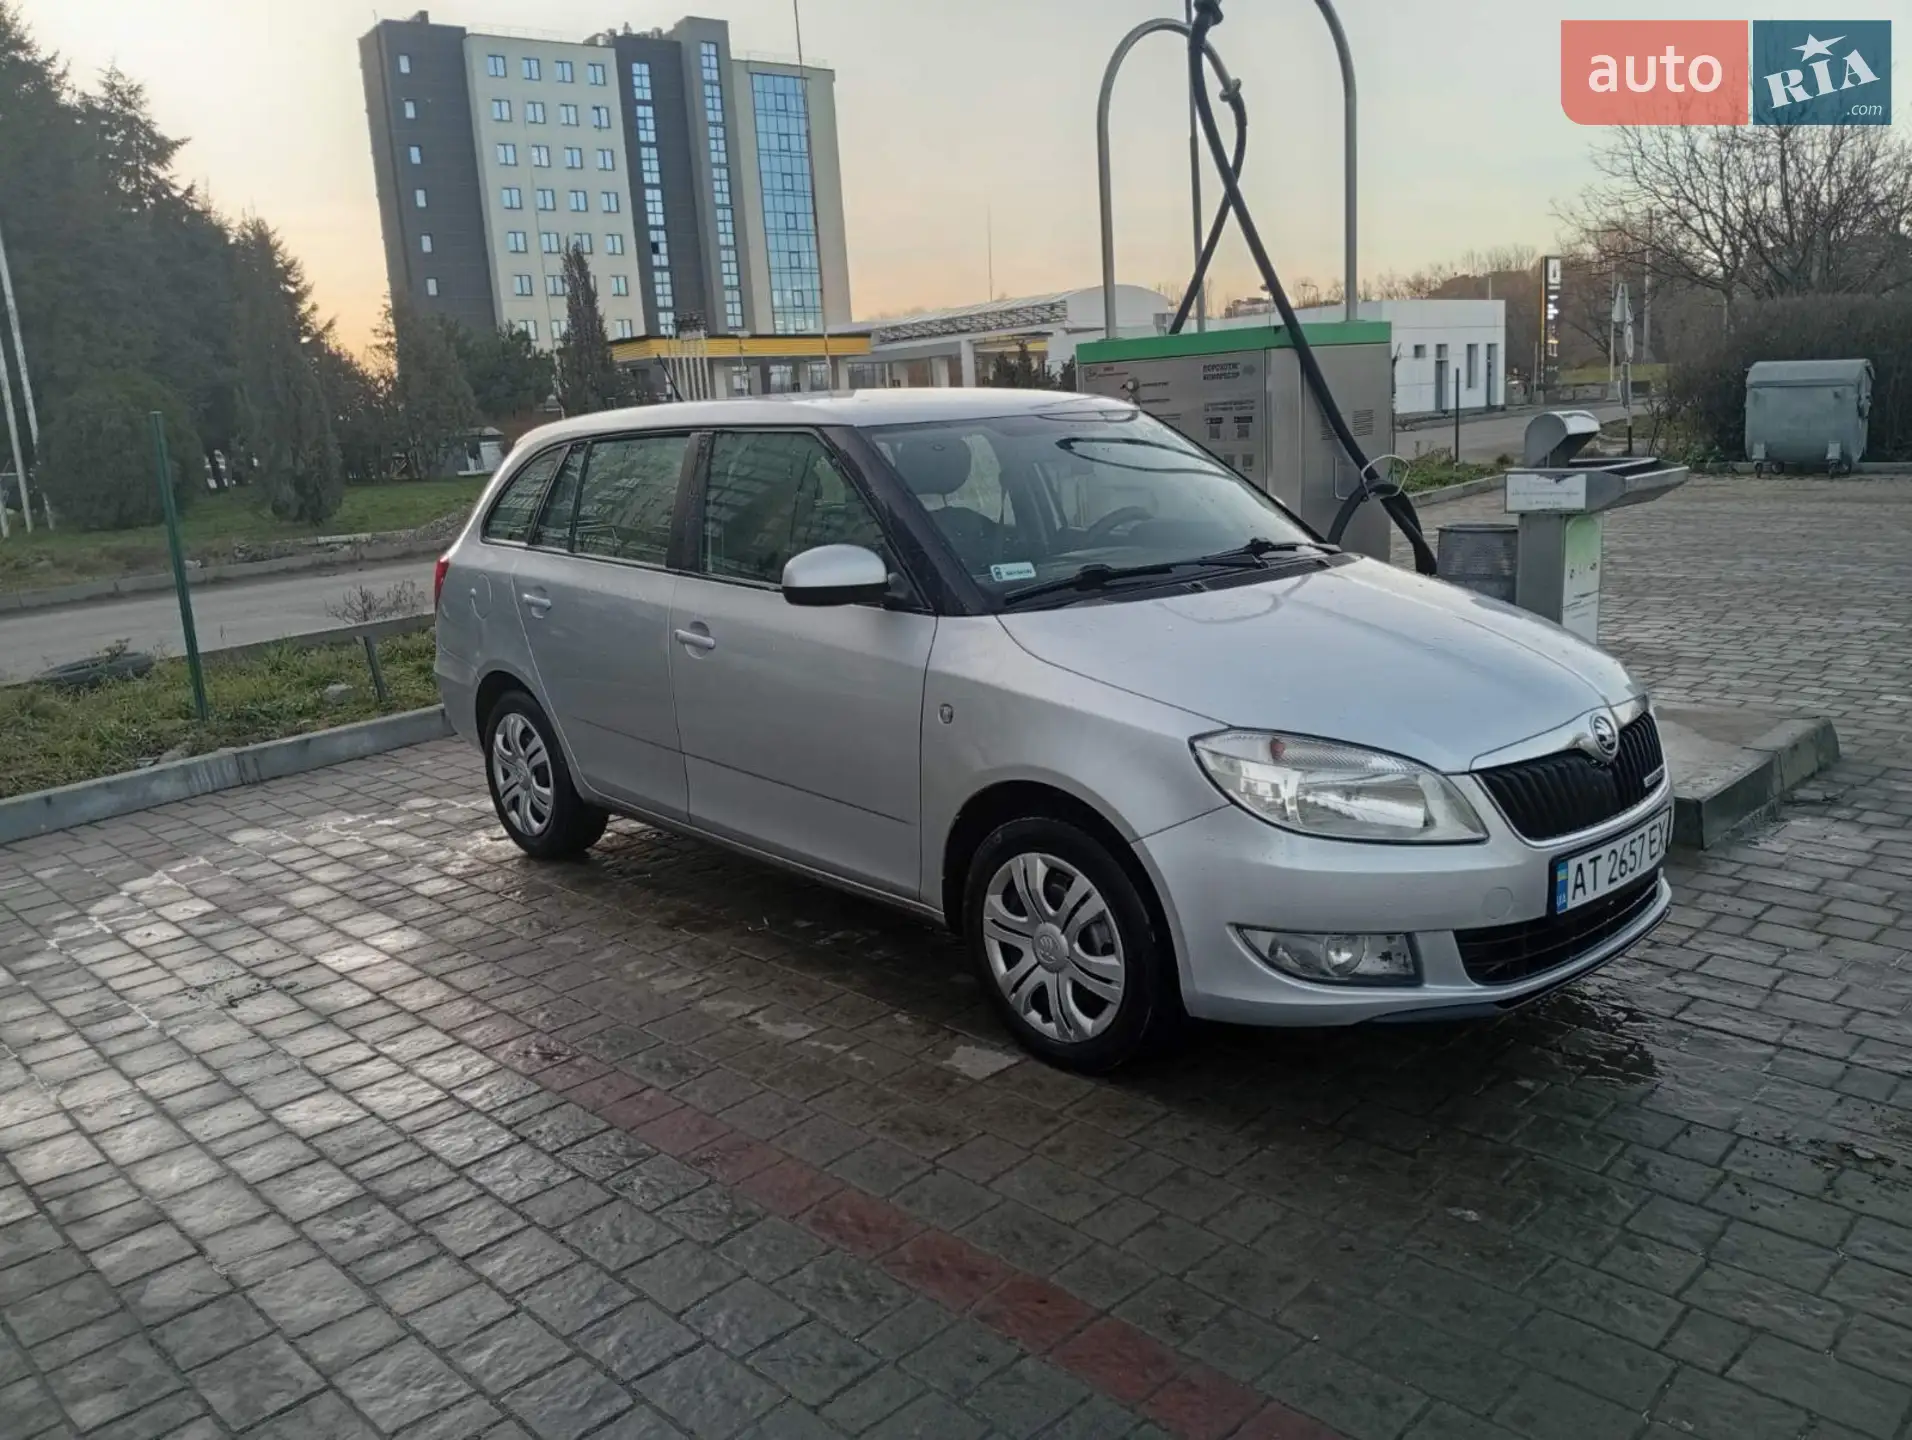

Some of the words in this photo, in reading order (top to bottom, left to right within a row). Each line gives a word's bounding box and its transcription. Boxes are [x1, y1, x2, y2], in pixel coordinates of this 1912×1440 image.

[1572, 855, 1603, 901] AT
[1607, 832, 1646, 886] 2657
[1649, 820, 1666, 861] EX
